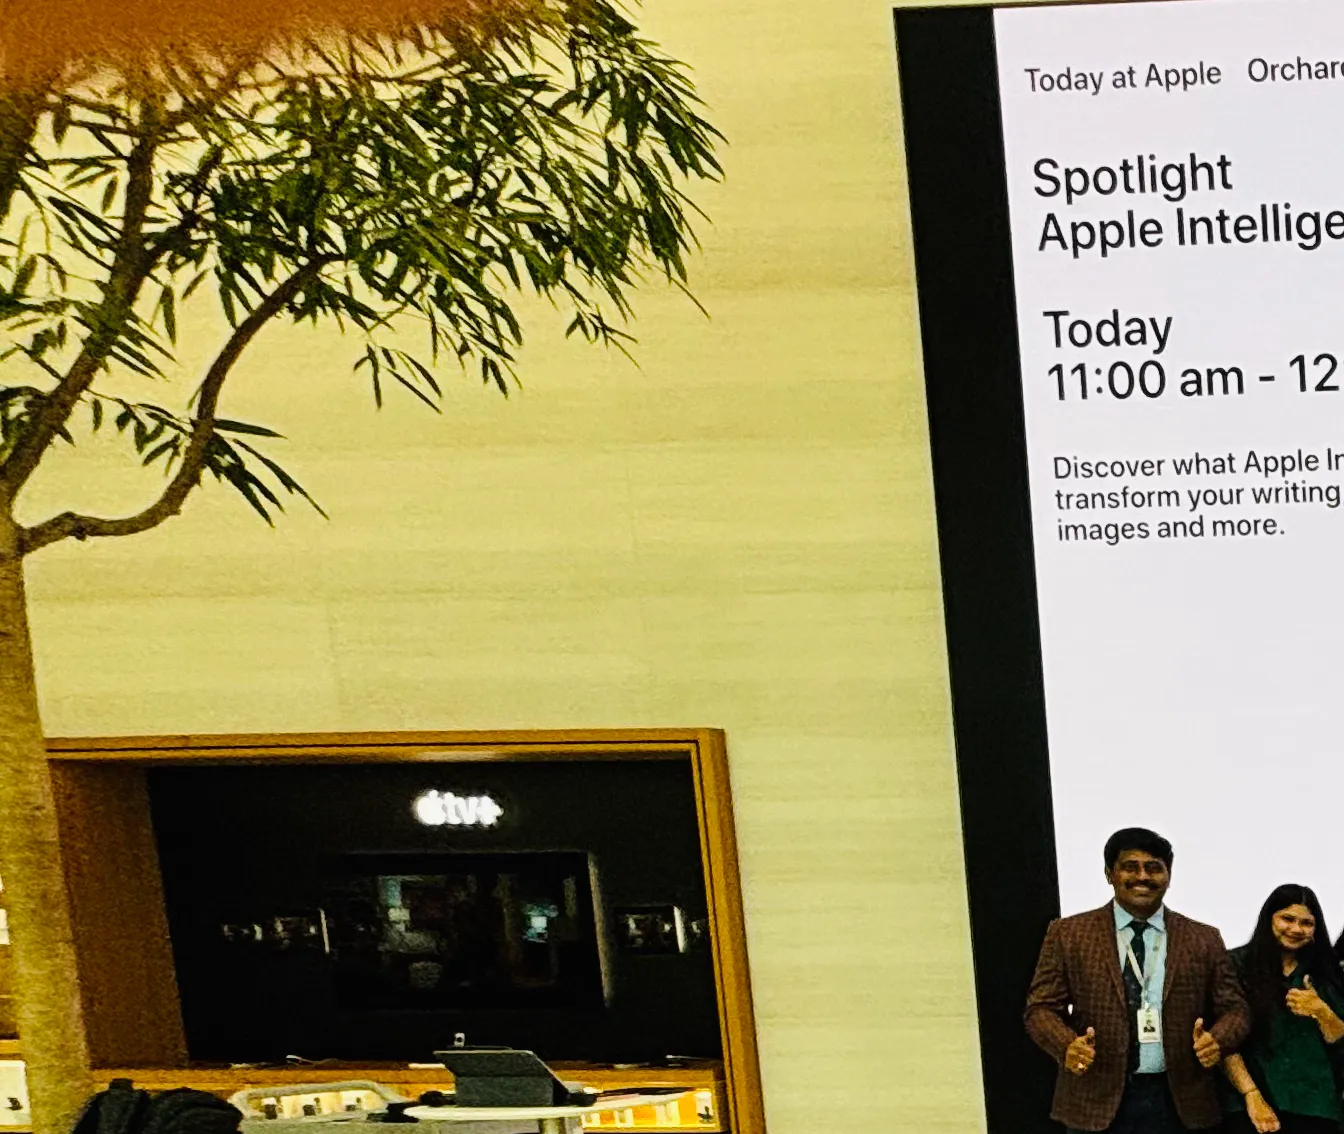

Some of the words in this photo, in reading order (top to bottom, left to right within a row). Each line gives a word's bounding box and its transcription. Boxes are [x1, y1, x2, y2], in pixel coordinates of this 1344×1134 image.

[1023, 66, 1104, 96] Today
[1111, 65, 1138, 90] at
[1144, 60, 1222, 93] Apple
[1033, 152, 1234, 206] Spotlight
[1037, 209, 1164, 260] Apple
[1042, 308, 1173, 356] Today
[1047, 359, 1167, 401] 11:00
[1179, 366, 1245, 398] am
[1053, 455, 1166, 480] Discover
[1171, 451, 1237, 476] what
[1243, 448, 1320, 479] Apple
[1054, 485, 1181, 511] transform
[1187, 487, 1245, 513] your
[1057, 518, 1151, 547] images
[1157, 514, 1205, 539] and
[1212, 518, 1285, 538] more.
